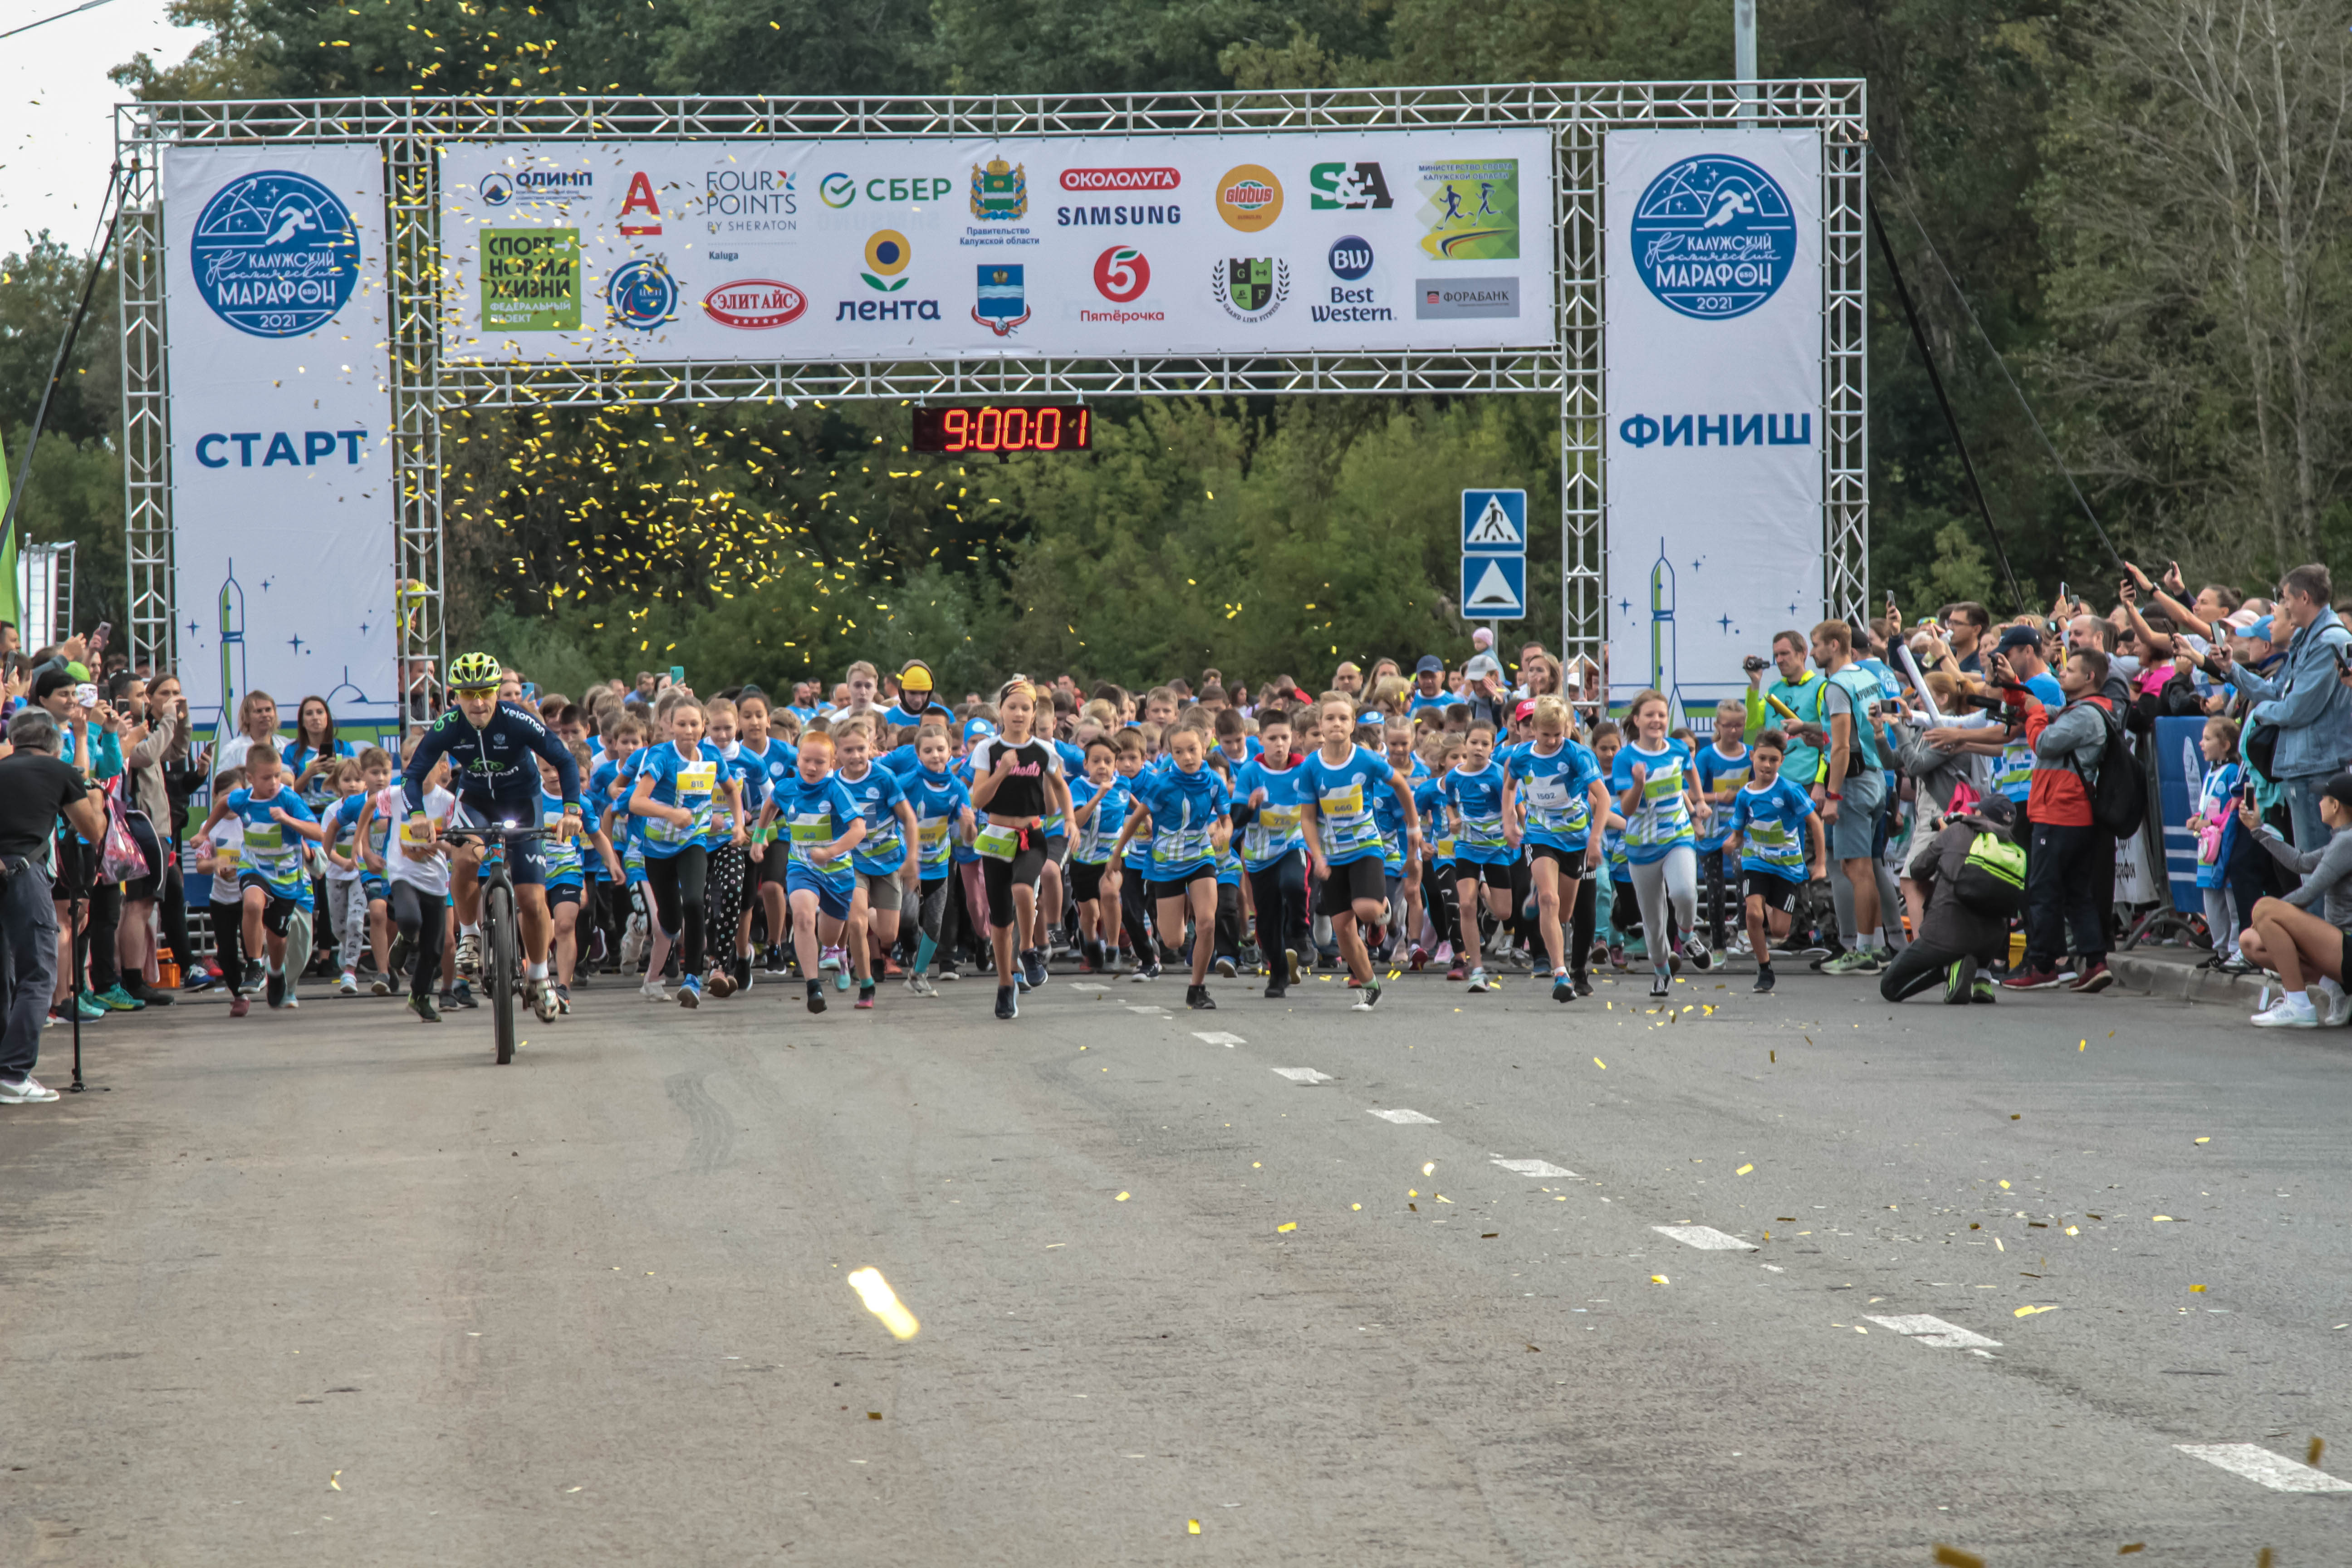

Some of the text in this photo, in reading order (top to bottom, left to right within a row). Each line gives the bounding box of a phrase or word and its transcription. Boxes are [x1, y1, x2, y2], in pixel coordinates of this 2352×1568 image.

[516, 172, 593, 186] ОЛИМП
[706, 171, 774, 191] FOUR
[1065, 171, 1175, 187] ОКОЛОЛУГА
[1423, 172, 1470, 181] КАЛУЖСКОЙ
[866, 177, 952, 201] СБЕР
[1310, 162, 1394, 210] S&A
[707, 194, 797, 215] POINTS
[1058, 205, 1181, 226] SAMSUNG
[707, 220, 797, 231] BY SHERATON
[966, 226, 1030, 236] Правительство
[489, 237, 555, 255] СПОРТ
[960, 235, 1040, 246] Калужской области
[1687, 232, 1772, 250] КАЛУЖСКИЙ
[249, 250, 335, 268] КАЛУЖСКИЙ
[709, 251, 739, 261] Kaluga
[1334, 249, 1370, 269] BW
[1645, 231, 1782, 269] Космический
[490, 258, 570, 277] НОРМА
[1656, 262, 1772, 288] МАРАФОН
[218, 279, 336, 306] МАРАФОН
[490, 279, 570, 298] ЖИЗНИ
[1331, 286, 1374, 304] Best
[1443, 291, 1509, 302] ФОРАБАНК
[490, 300, 571, 312] ФЕДЕРАЛЬНЫЙ
[836, 299, 941, 321] лента
[1223, 303, 1242, 320] GRAND
[1259, 302, 1280, 321] FITNESS
[1696, 296, 1732, 310] 2021
[260, 314, 297, 328] 2021
[1081, 309, 1165, 323] Пятёрочка
[1311, 305, 1392, 323] Western
[944, 408, 1087, 451] 9:00:01
[1619, 412, 1811, 448] ФИНИШ
[196, 430, 368, 468] СТАРТ
[501, 706, 545, 737] veloman
